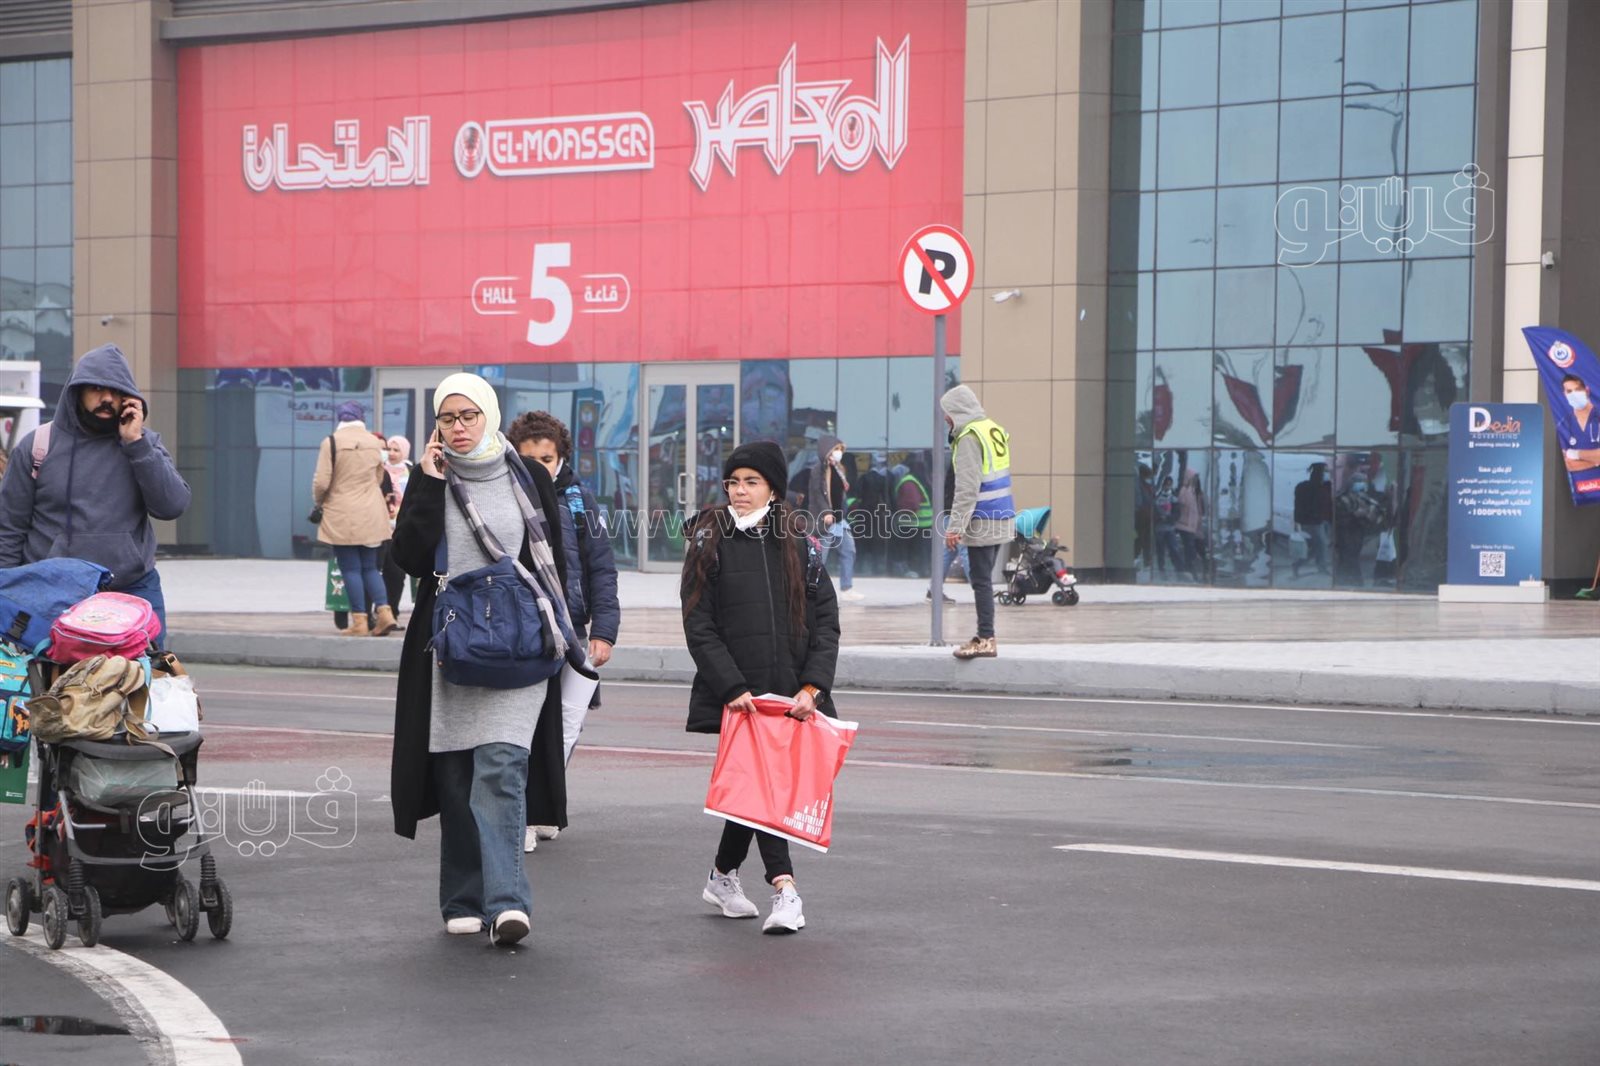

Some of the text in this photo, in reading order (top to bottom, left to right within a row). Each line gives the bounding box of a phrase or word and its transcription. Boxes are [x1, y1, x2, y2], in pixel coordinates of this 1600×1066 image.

[682, 33, 910, 192] المعاصر
[243, 115, 431, 191] الامتحان
[493, 123, 648, 164] EL-MOASSER
[482, 242, 573, 346] HALL 5
[584, 285, 618, 302] قاعة
[919, 248, 957, 295] P
